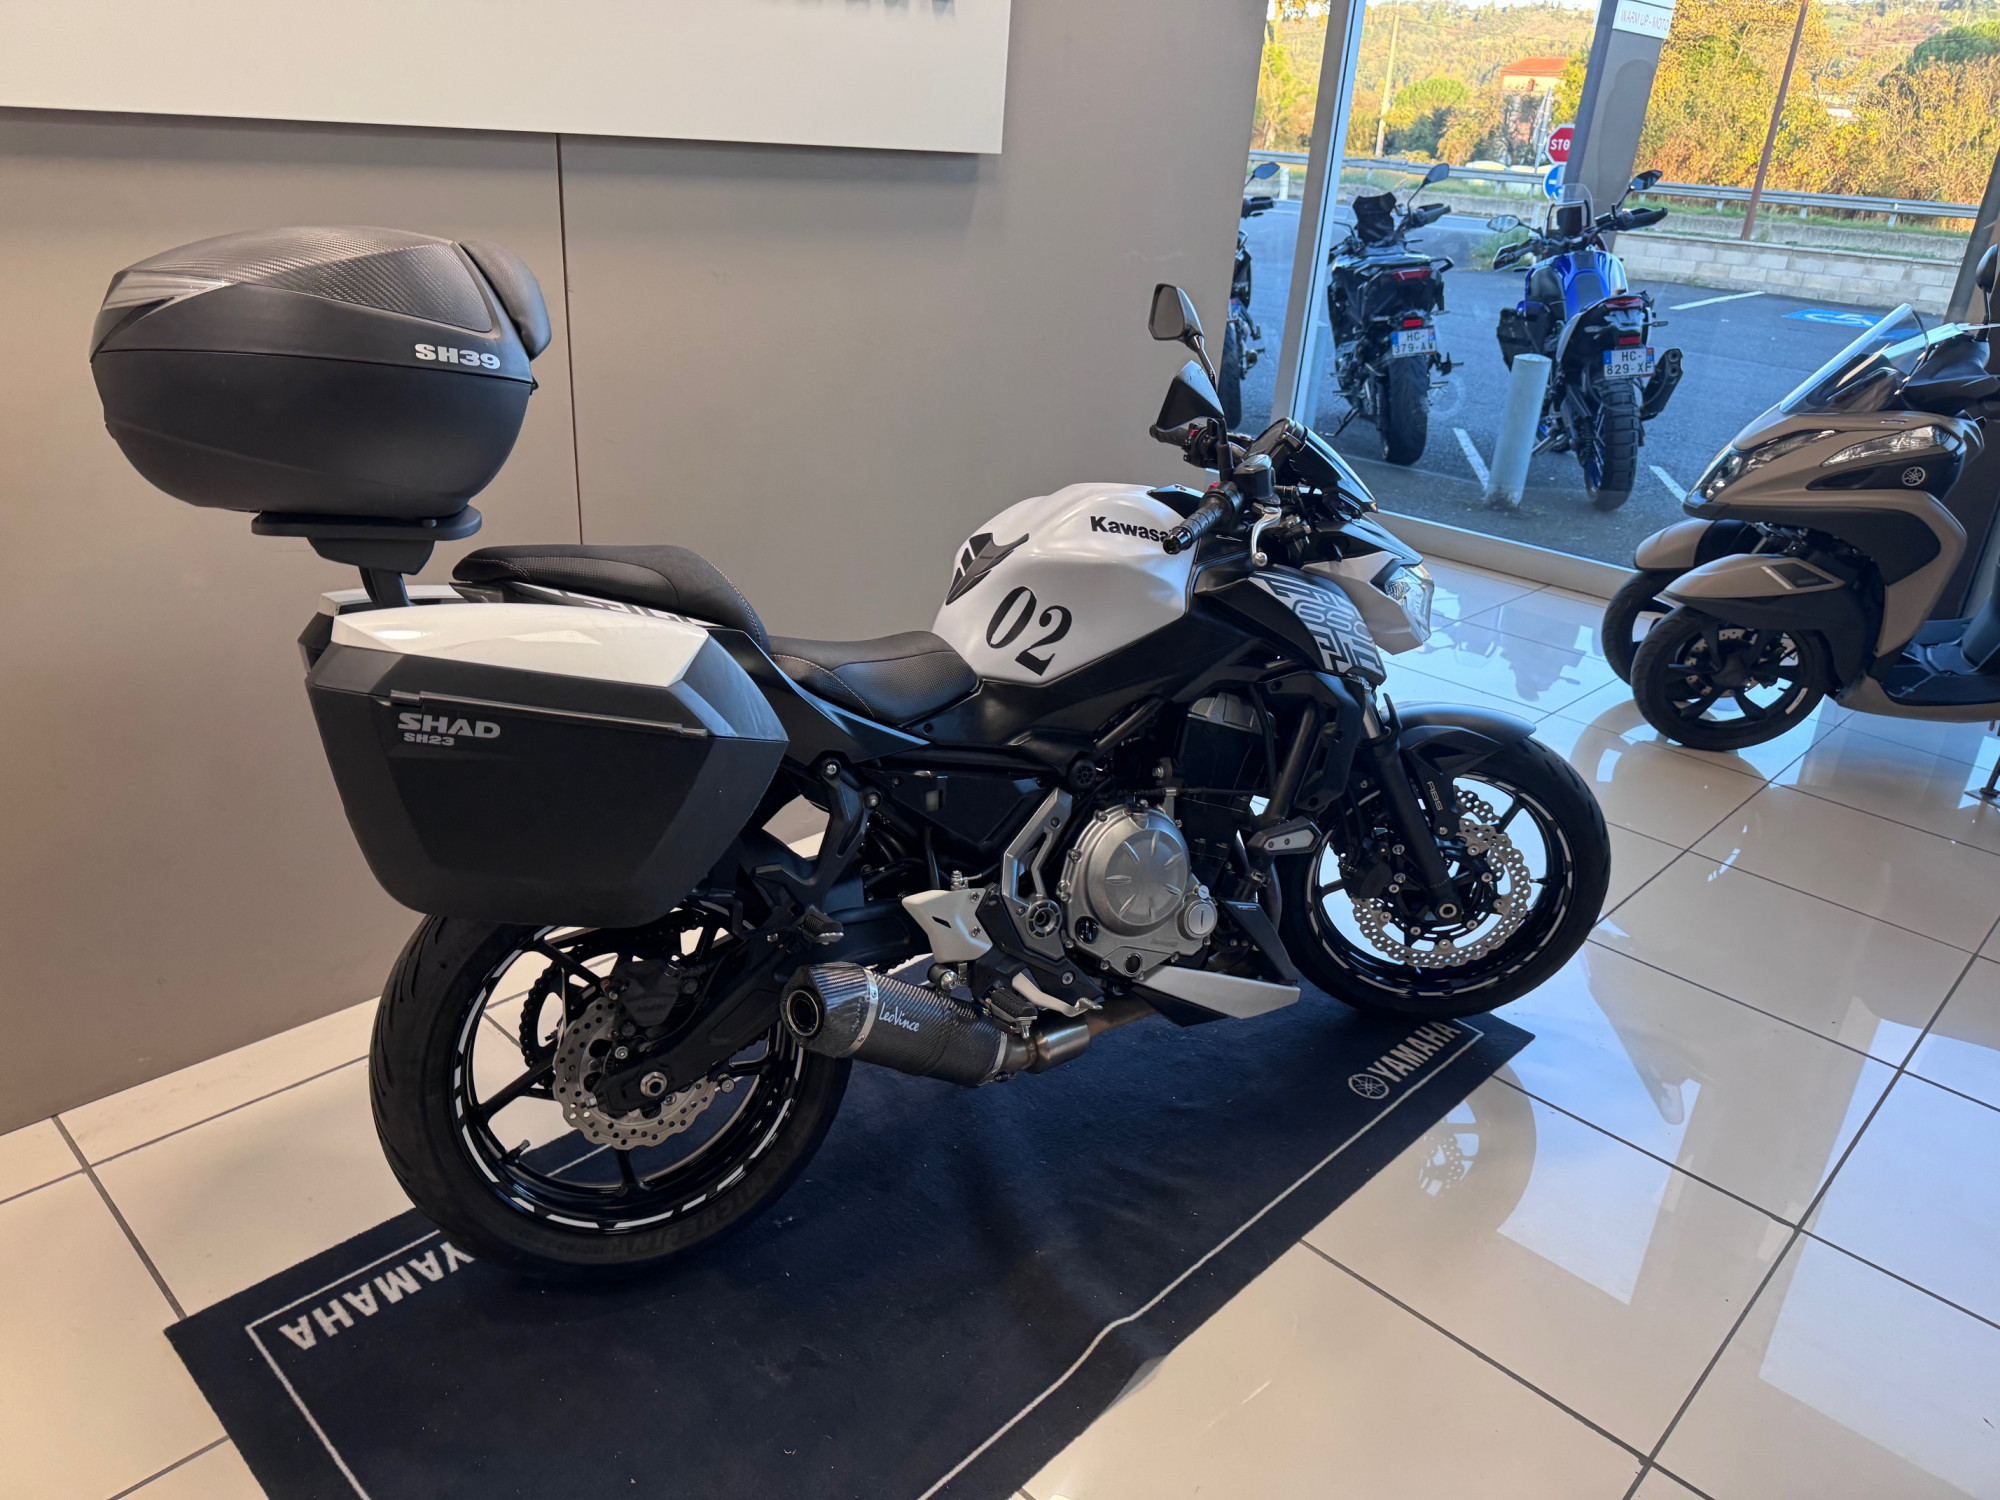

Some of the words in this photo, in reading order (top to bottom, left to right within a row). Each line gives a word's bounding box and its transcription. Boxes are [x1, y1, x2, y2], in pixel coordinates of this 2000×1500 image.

[1621, 9, 1640, 25] WARM
[1652, 16, 1670, 31] MOTO
[1550, 138, 1571, 151] STO
[414, 343, 501, 370] SH39
[1606, 361, 1652, 375] 829-XF
[1090, 515, 1172, 543] Kawasa
[985, 585, 1072, 676] 02
[397, 712, 501, 739] SHAD
[403, 732, 455, 746] SH23
[1427, 780, 1444, 811] ABS
[878, 1001, 920, 1033] LeoVince
[1366, 1020, 1462, 1083] YAMAHA
[278, 1241, 476, 1350] YAMAHA
